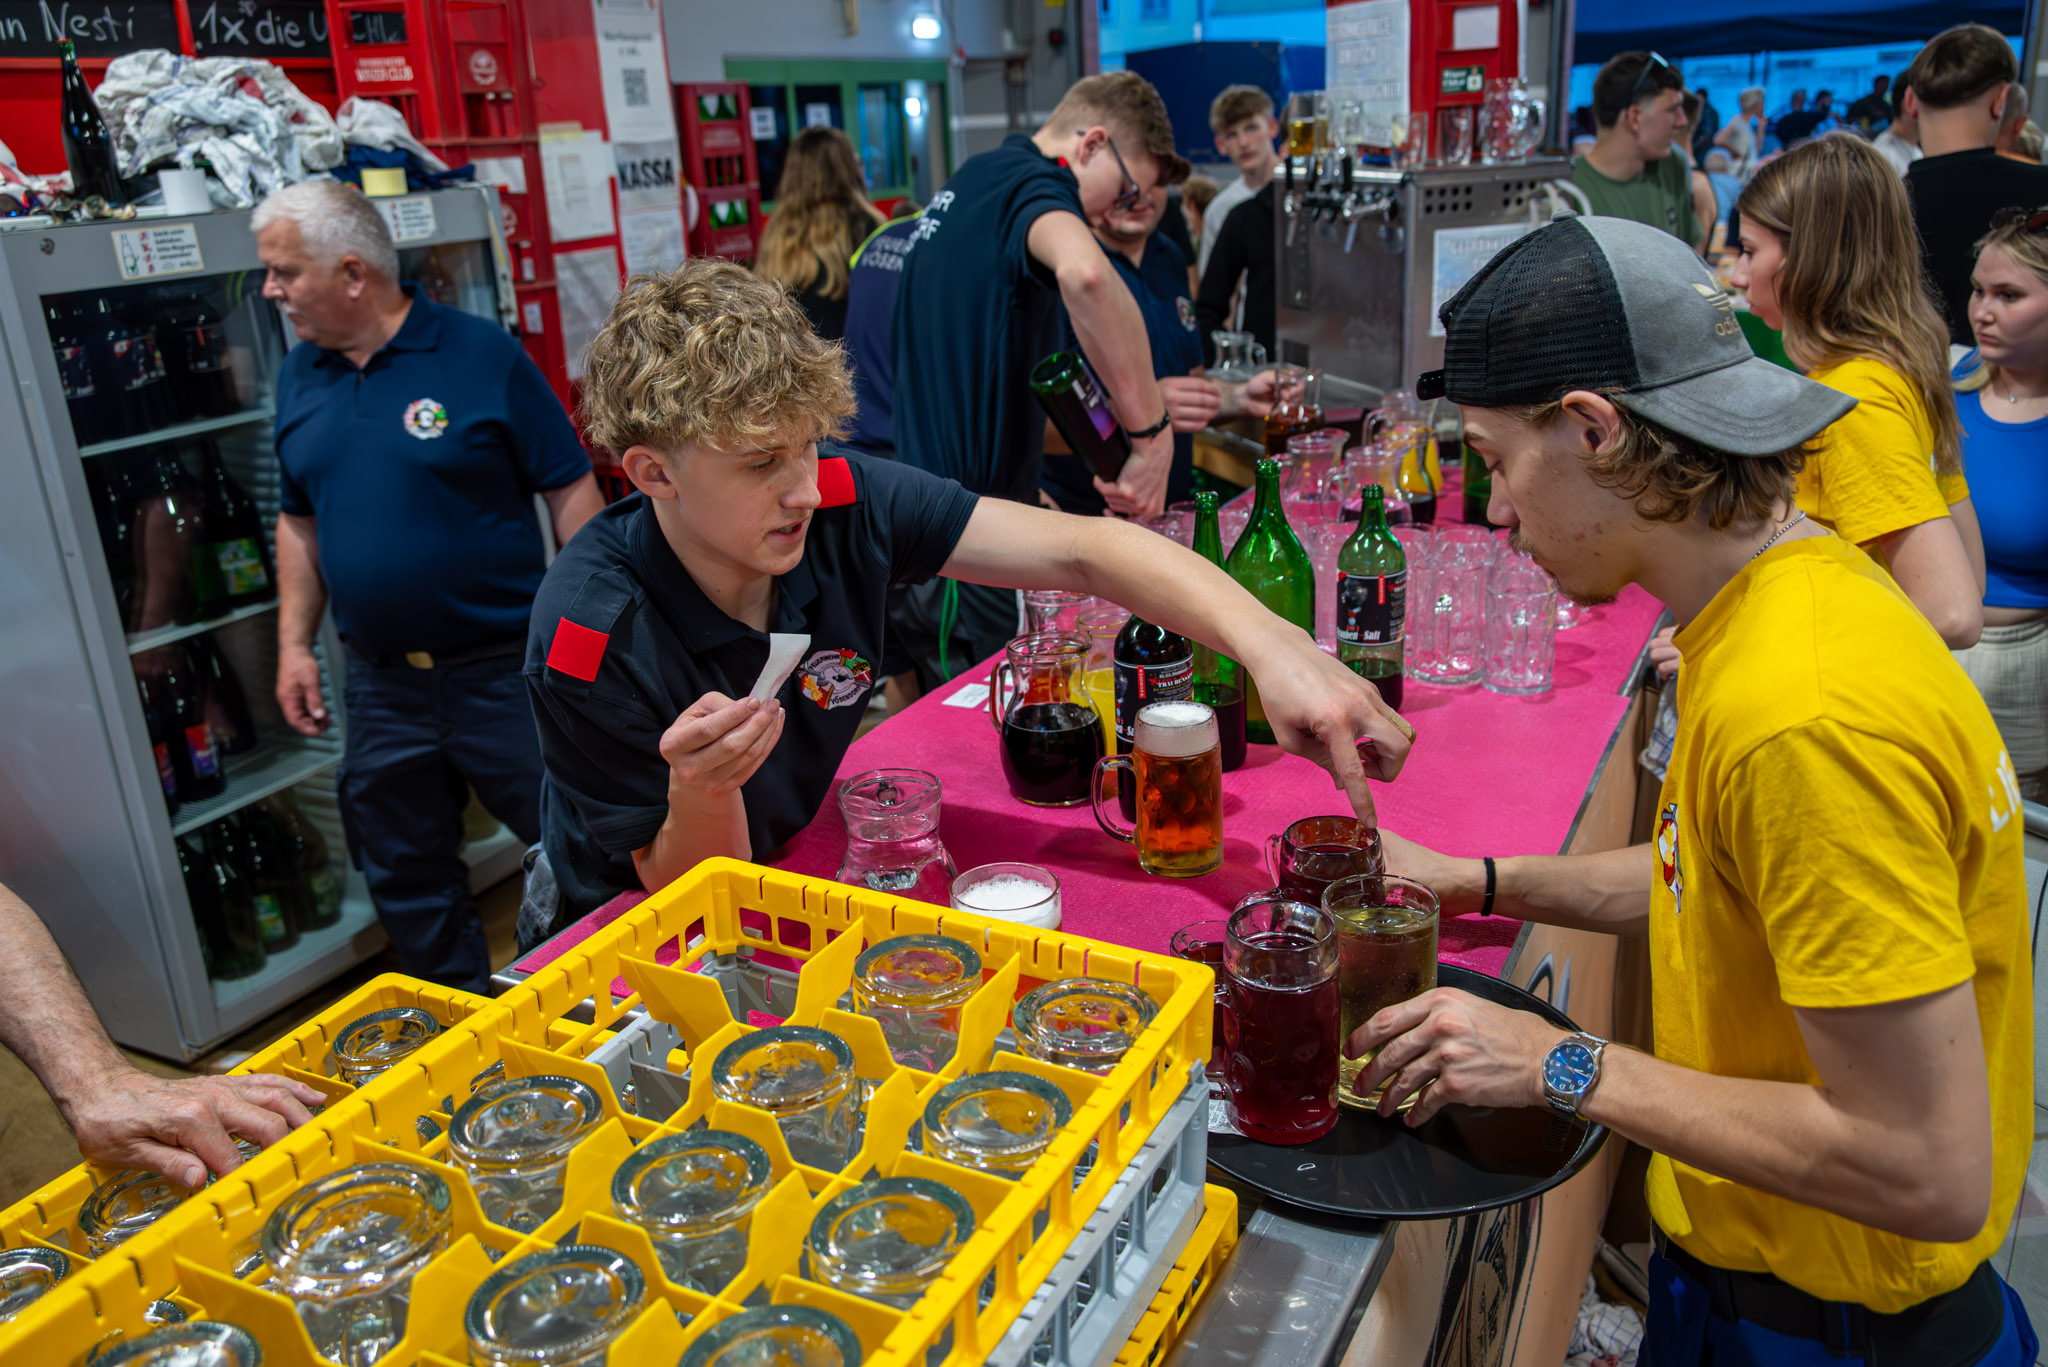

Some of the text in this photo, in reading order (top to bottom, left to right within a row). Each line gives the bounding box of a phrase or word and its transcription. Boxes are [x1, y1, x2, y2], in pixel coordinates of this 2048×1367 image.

[39, 0, 135, 42] Nesti
[255, 9, 306, 48] die
[618, 157, 675, 191] KASSA
[831, 686, 861, 704] VÖSENDORF
